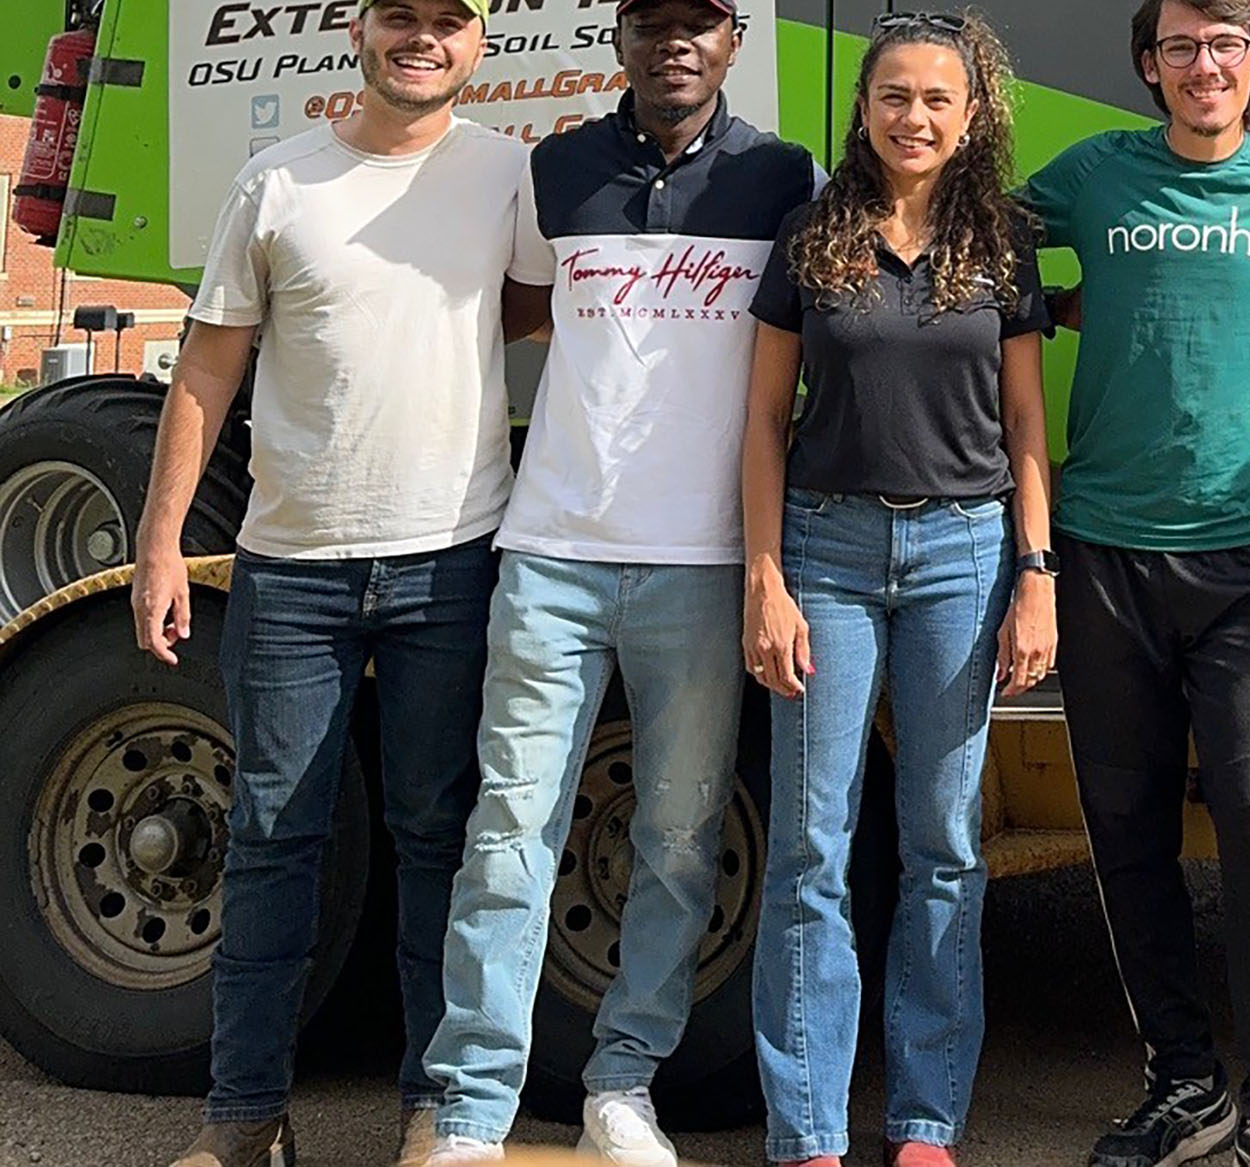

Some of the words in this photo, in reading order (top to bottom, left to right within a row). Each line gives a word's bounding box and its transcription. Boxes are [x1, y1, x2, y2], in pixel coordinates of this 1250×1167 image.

[188, 57, 263, 87] OSU
[273, 53, 360, 79] PLAN
[483, 33, 560, 58] SOIL
[561, 248, 647, 305] Tommy
[651, 244, 761, 307] Hilfiger
